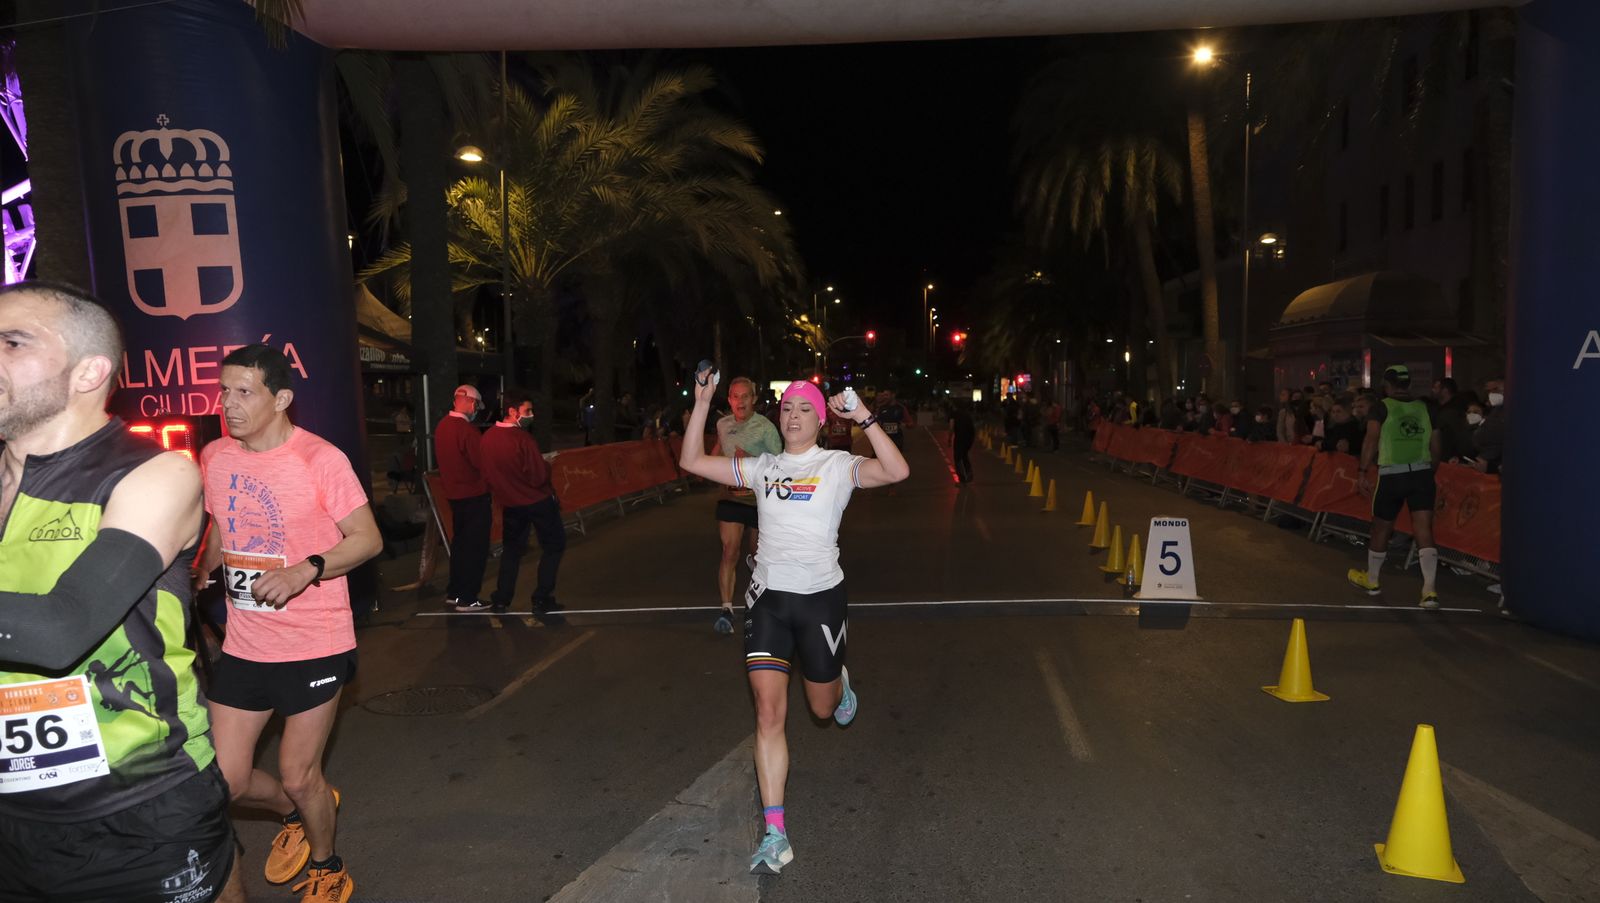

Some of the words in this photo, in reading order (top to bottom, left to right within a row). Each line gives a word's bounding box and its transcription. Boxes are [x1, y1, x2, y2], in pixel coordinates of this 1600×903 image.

[117, 334, 308, 389] LMEA
[140, 391, 223, 417] CIUDA
[1159, 541, 1181, 576] 5
[0, 714, 68, 755] 56
[9, 756, 37, 772] JORGE
